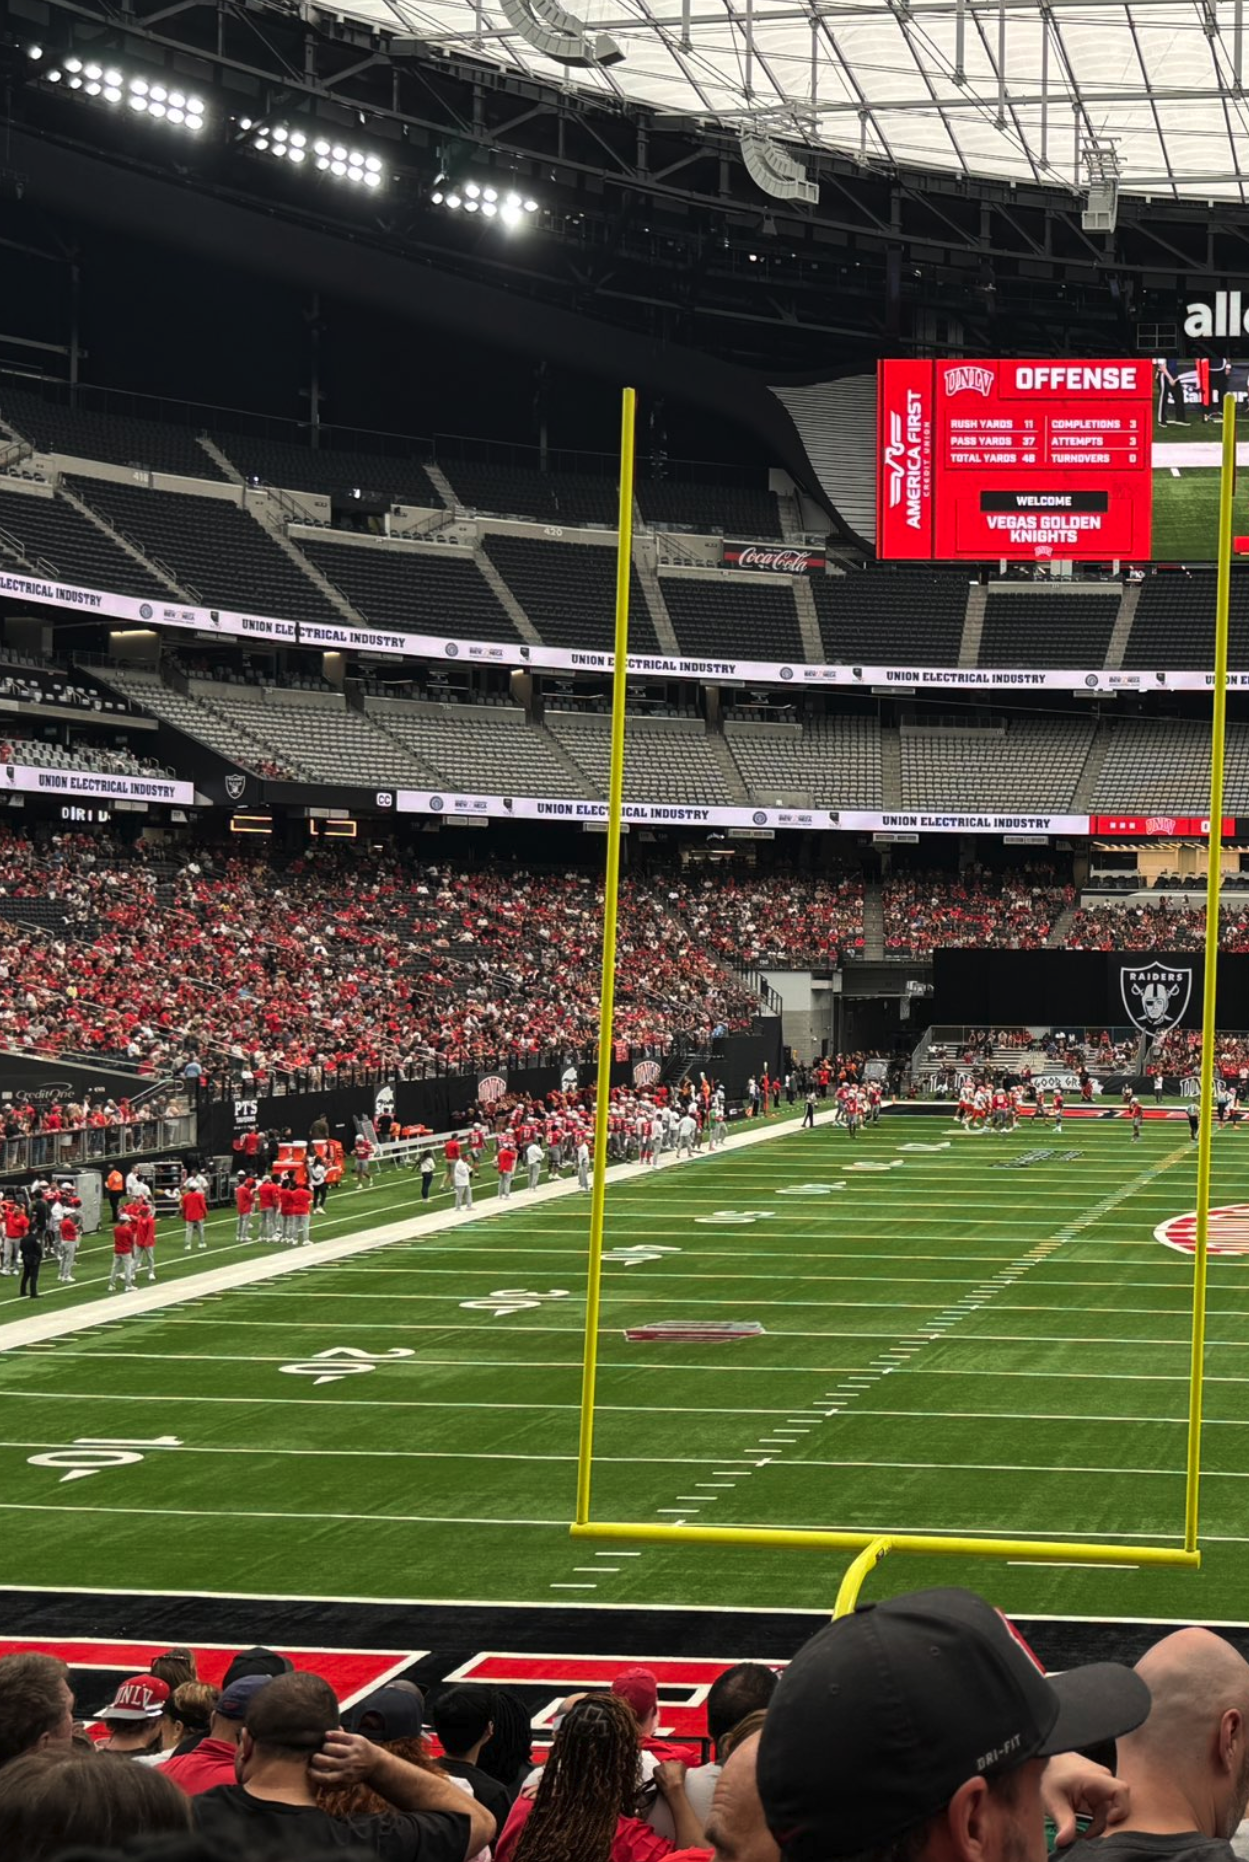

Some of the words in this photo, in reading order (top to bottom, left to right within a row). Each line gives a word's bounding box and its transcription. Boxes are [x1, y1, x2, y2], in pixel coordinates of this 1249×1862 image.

[944, 366, 994, 397] UNLV
[1016, 367, 1137, 390] OFFENSE
[907, 390, 921, 443] FIRST
[951, 420, 978, 429] RUSH
[980, 420, 1013, 429] YARDS
[1024, 420, 1034, 429] 11
[1051, 420, 1120, 429] COMPLETIONS
[951, 437, 977, 446] PASS
[979, 437, 1012, 446] YARDS
[1022, 437, 1035, 446] 37
[1051, 437, 1103, 446] ATTEMPTS
[951, 454, 981, 463] TOTAL
[983, 454, 1017, 463] YARDS
[1051, 454, 1110, 463] TURNOVERS
[906, 446, 921, 529] AMERICA
[1016, 496, 1072, 506] WELCOME
[987, 516, 1038, 529] VEGAS
[1040, 516, 1101, 529] GOLDEN
[1010, 530, 1077, 543] KNIGHTS
[739, 546, 812, 572] Coca-Cola
[0, 576, 53, 597] LECTRICAL
[56, 588, 102, 607] INDUSTRY
[242, 618, 272, 633] UNION
[349, 632, 406, 648] INDUSTRY
[571, 653, 605, 667] UNION
[607, 656, 676, 672] ECTRICAL
[679, 661, 736, 674] INDUSTRY
[886, 671, 920, 682] UNION
[922, 671, 989, 683] ELECTRICAL
[992, 673, 1046, 684] INDUSTRY
[1205, 675, 1238, 685] UON
[39, 773, 67, 788] UNION
[70, 776, 128, 794] ELECTRICAL
[130, 781, 176, 798] INDUSTRY
[537, 802, 573, 815] UNION
[576, 804, 648, 819] ELECTICAL
[650, 807, 709, 821] INDUSTRY
[882, 816, 918, 827] UNION
[920, 816, 991, 828] ELECTRICAL
[993, 817, 1051, 829] INDUSTRY
[1130, 972, 1183, 981] RAIDERS
[458, 1288, 570, 1310] 30
[278, 1346, 416, 1376] 20
[27, 1435, 184, 1469] 10
[976, 1733, 1021, 1771] DRI-FIT
